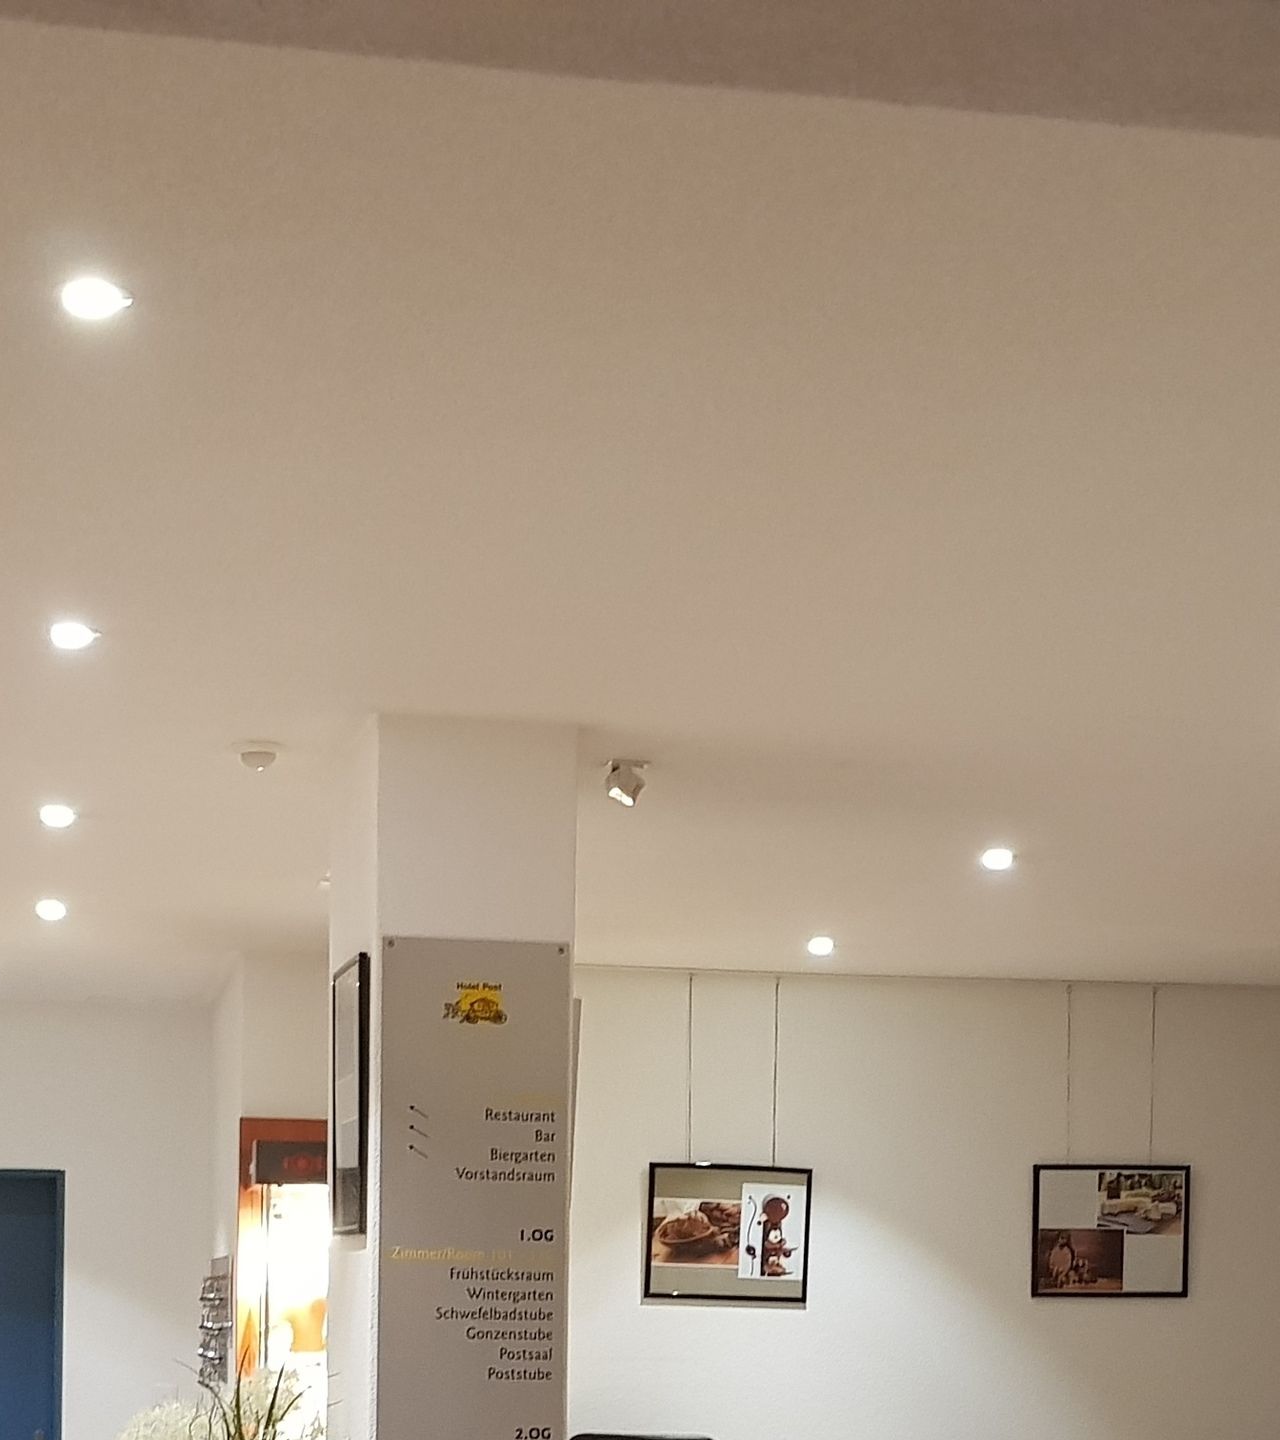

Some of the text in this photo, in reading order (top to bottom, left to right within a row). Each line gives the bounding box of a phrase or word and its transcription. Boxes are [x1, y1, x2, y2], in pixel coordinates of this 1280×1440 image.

[484, 1108, 556, 1123] Restaurant
[534, 1129, 556, 1143] Bar
[490, 1148, 556, 1164] Biergarten
[455, 1167, 556, 1183] Vorstandsraum
[519, 1229, 555, 1242] 1.OG
[449, 1267, 554, 1282] Frühstücksraum
[466, 1287, 554, 1304] Wintergarten
[435, 1306, 554, 1321] Schwefelbadstube
[466, 1326, 554, 1341] Gonzenstube
[499, 1347, 553, 1361] Postsaal
[487, 1366, 553, 1381] Poststube
[514, 1427, 552, 1440] 2.OG
